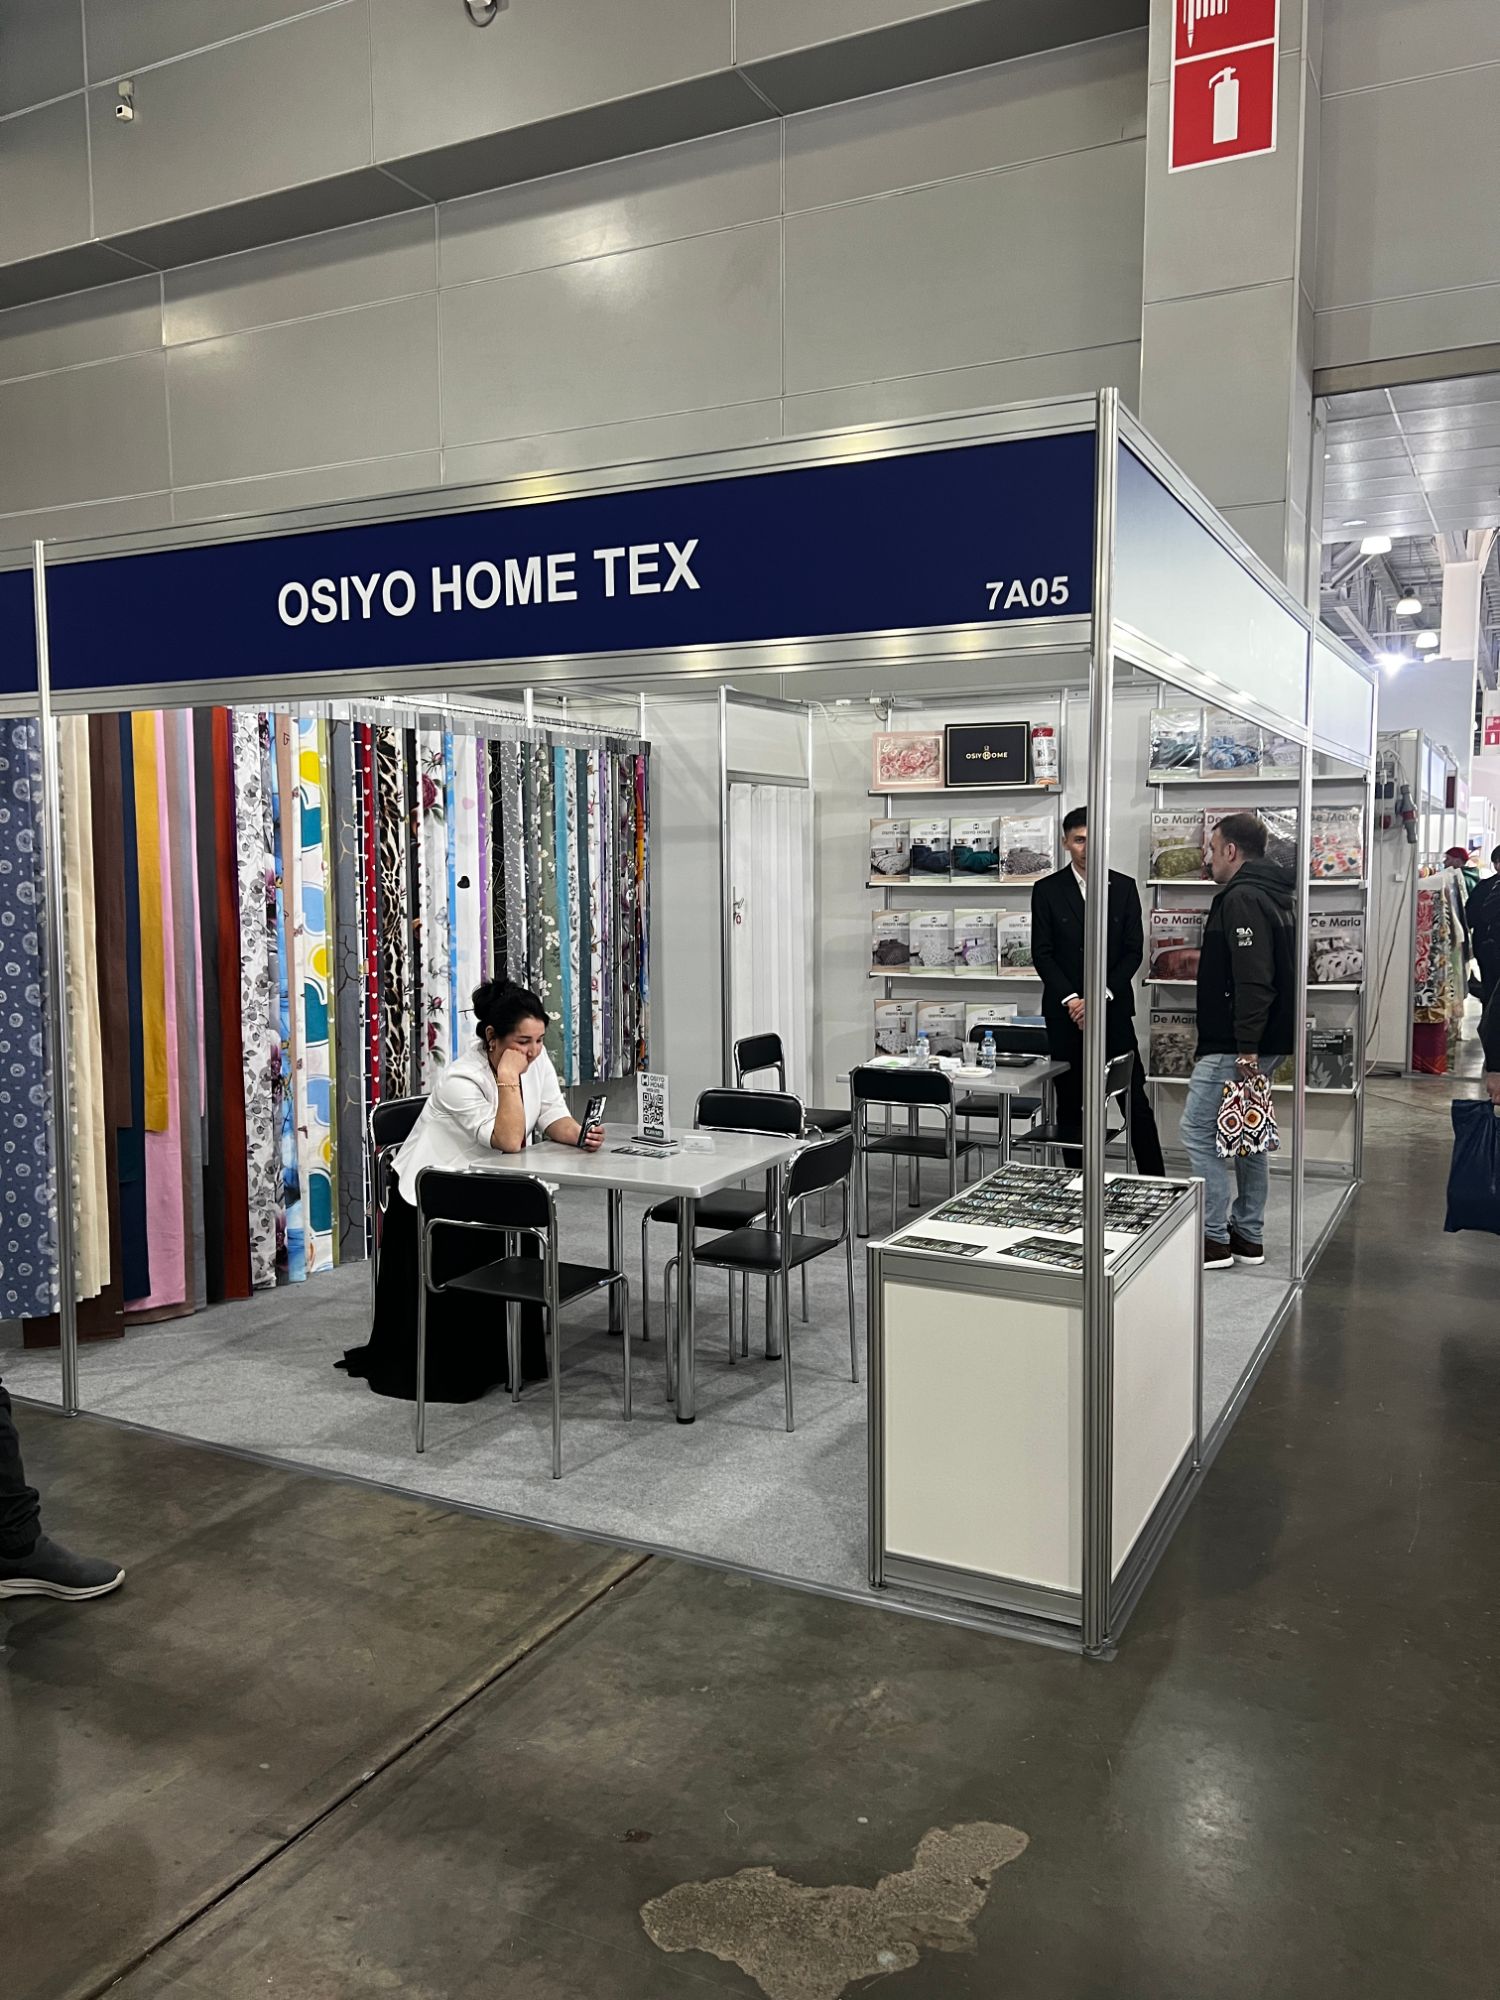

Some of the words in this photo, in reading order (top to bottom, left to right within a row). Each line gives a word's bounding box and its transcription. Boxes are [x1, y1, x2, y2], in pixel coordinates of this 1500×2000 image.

[278, 569, 416, 627] OSIYO
[431, 552, 578, 613] HOME
[593, 538, 701, 598] TEX
[985, 575, 1070, 611] 7A05
[1153, 814, 1169, 824] De
[1171, 814, 1205, 824] Maria
[1153, 915, 1169, 925] De
[1171, 915, 1203, 925] Maria
[1311, 918, 1327, 928] De
[1329, 916, 1362, 927] Maria
[1153, 1014, 1168, 1024] De
[1171, 1015, 1195, 1024] Mari
